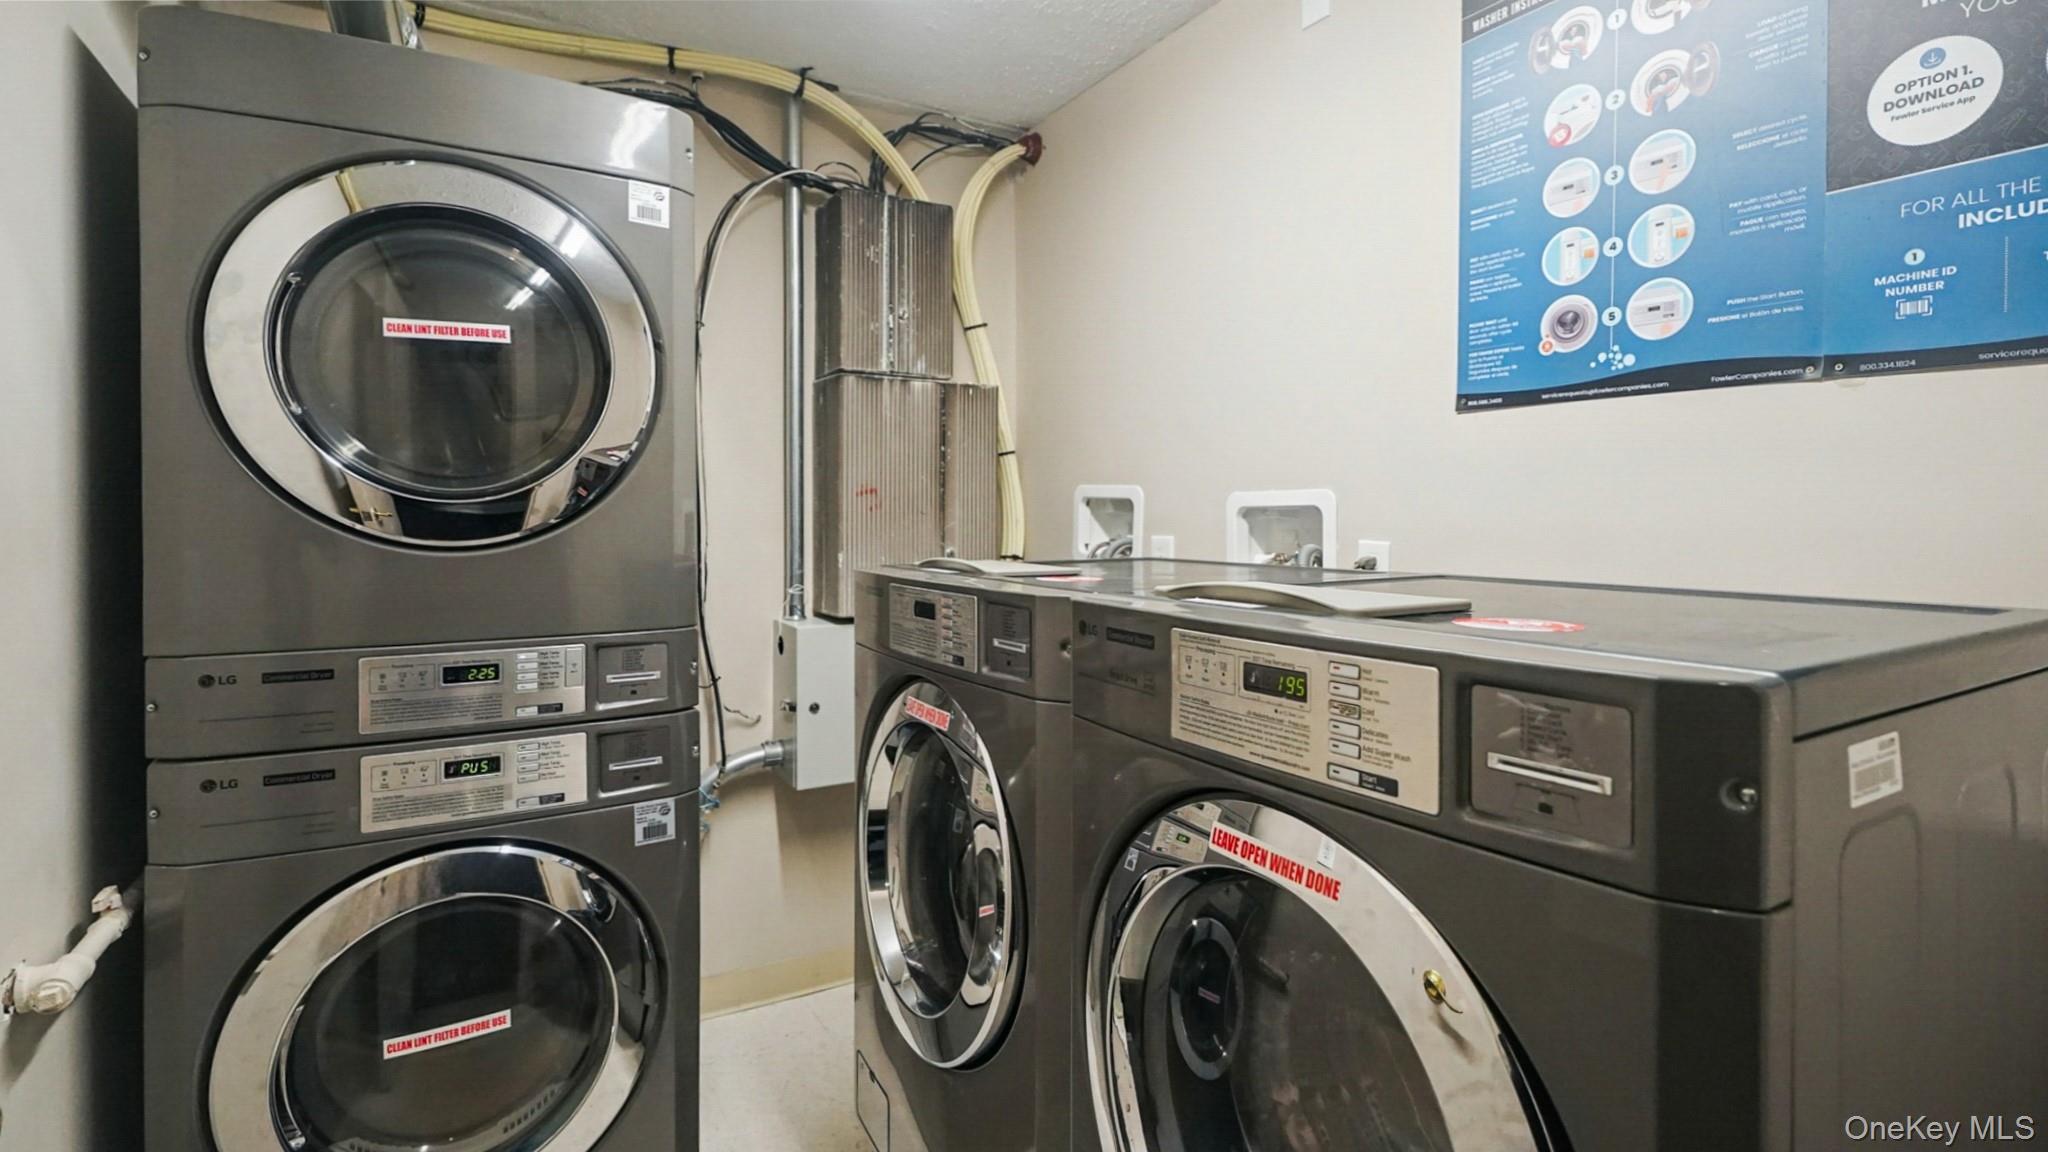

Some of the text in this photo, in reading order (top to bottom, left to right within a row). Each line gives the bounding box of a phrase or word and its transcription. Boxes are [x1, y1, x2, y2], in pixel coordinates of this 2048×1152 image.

[1472, 6, 1509, 33] WASHER
[1613, 13, 1620, 25] 1
[1894, 65, 1973, 94] OPTION 1.
[1883, 77, 1984, 113] DOWNLOAD
[1890, 95, 1976, 123] Fowler Service App
[1610, 169, 1619, 181] 3
[1900, 175, 2042, 219] FOR ALL THE
[1609, 242, 1617, 251] 4
[1874, 265, 1958, 286] MACHINE ID
[1885, 280, 1945, 297] NUMBER
[1608, 312, 1616, 321] 5
[386, 322, 507, 339] CLEAN LINT FILTER BEFORE USE
[218, 675, 237, 685] LG
[219, 779, 238, 790] LG
[1212, 827, 1341, 901] LEAVE OPEN WHEN DONE
[386, 1015, 507, 1054] CLEAN LINT FILTER BEFORE USE
